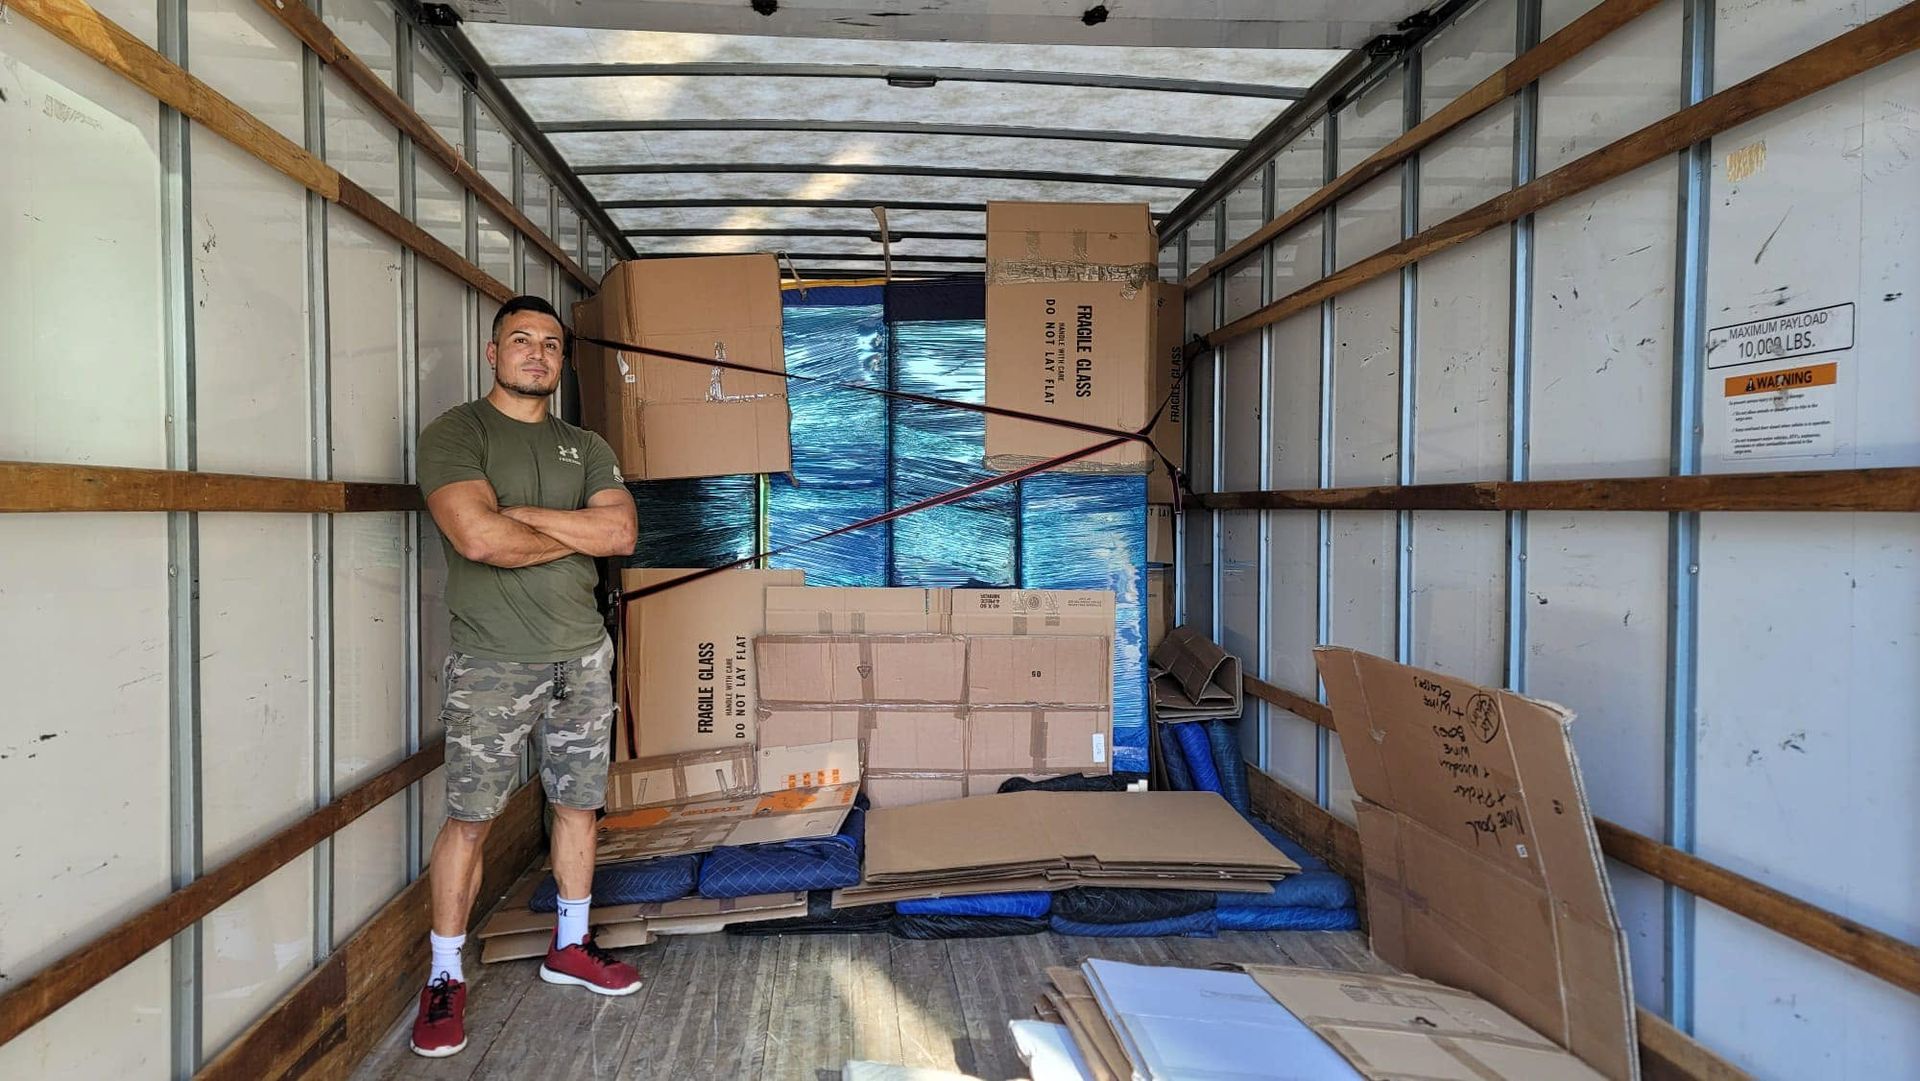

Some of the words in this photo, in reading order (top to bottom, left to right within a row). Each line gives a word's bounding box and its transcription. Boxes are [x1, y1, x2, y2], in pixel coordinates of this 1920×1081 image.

[1045, 299, 1055, 315] DO
[1045, 322, 1055, 346] NOT
[1076, 305, 1092, 353] FRAGILE
[1729, 321, 1778, 339] MAXIMUM
[1780, 312, 1828, 331] PAYLOAD
[1786, 331, 1816, 351] LBS.
[1045, 352, 1055, 372] LAY
[1171, 346, 1182, 379] GLASS
[1076, 359, 1092, 398] GLASS
[1044, 379, 1054, 405] FLAT
[698, 642, 714, 681] GLASS
[736, 635, 746, 662] FLAT
[736, 667, 746, 687] LAY
[698, 687, 714, 734] FRAGILE
[736, 693, 746, 717] NOT
[735, 722, 745, 739] DO
